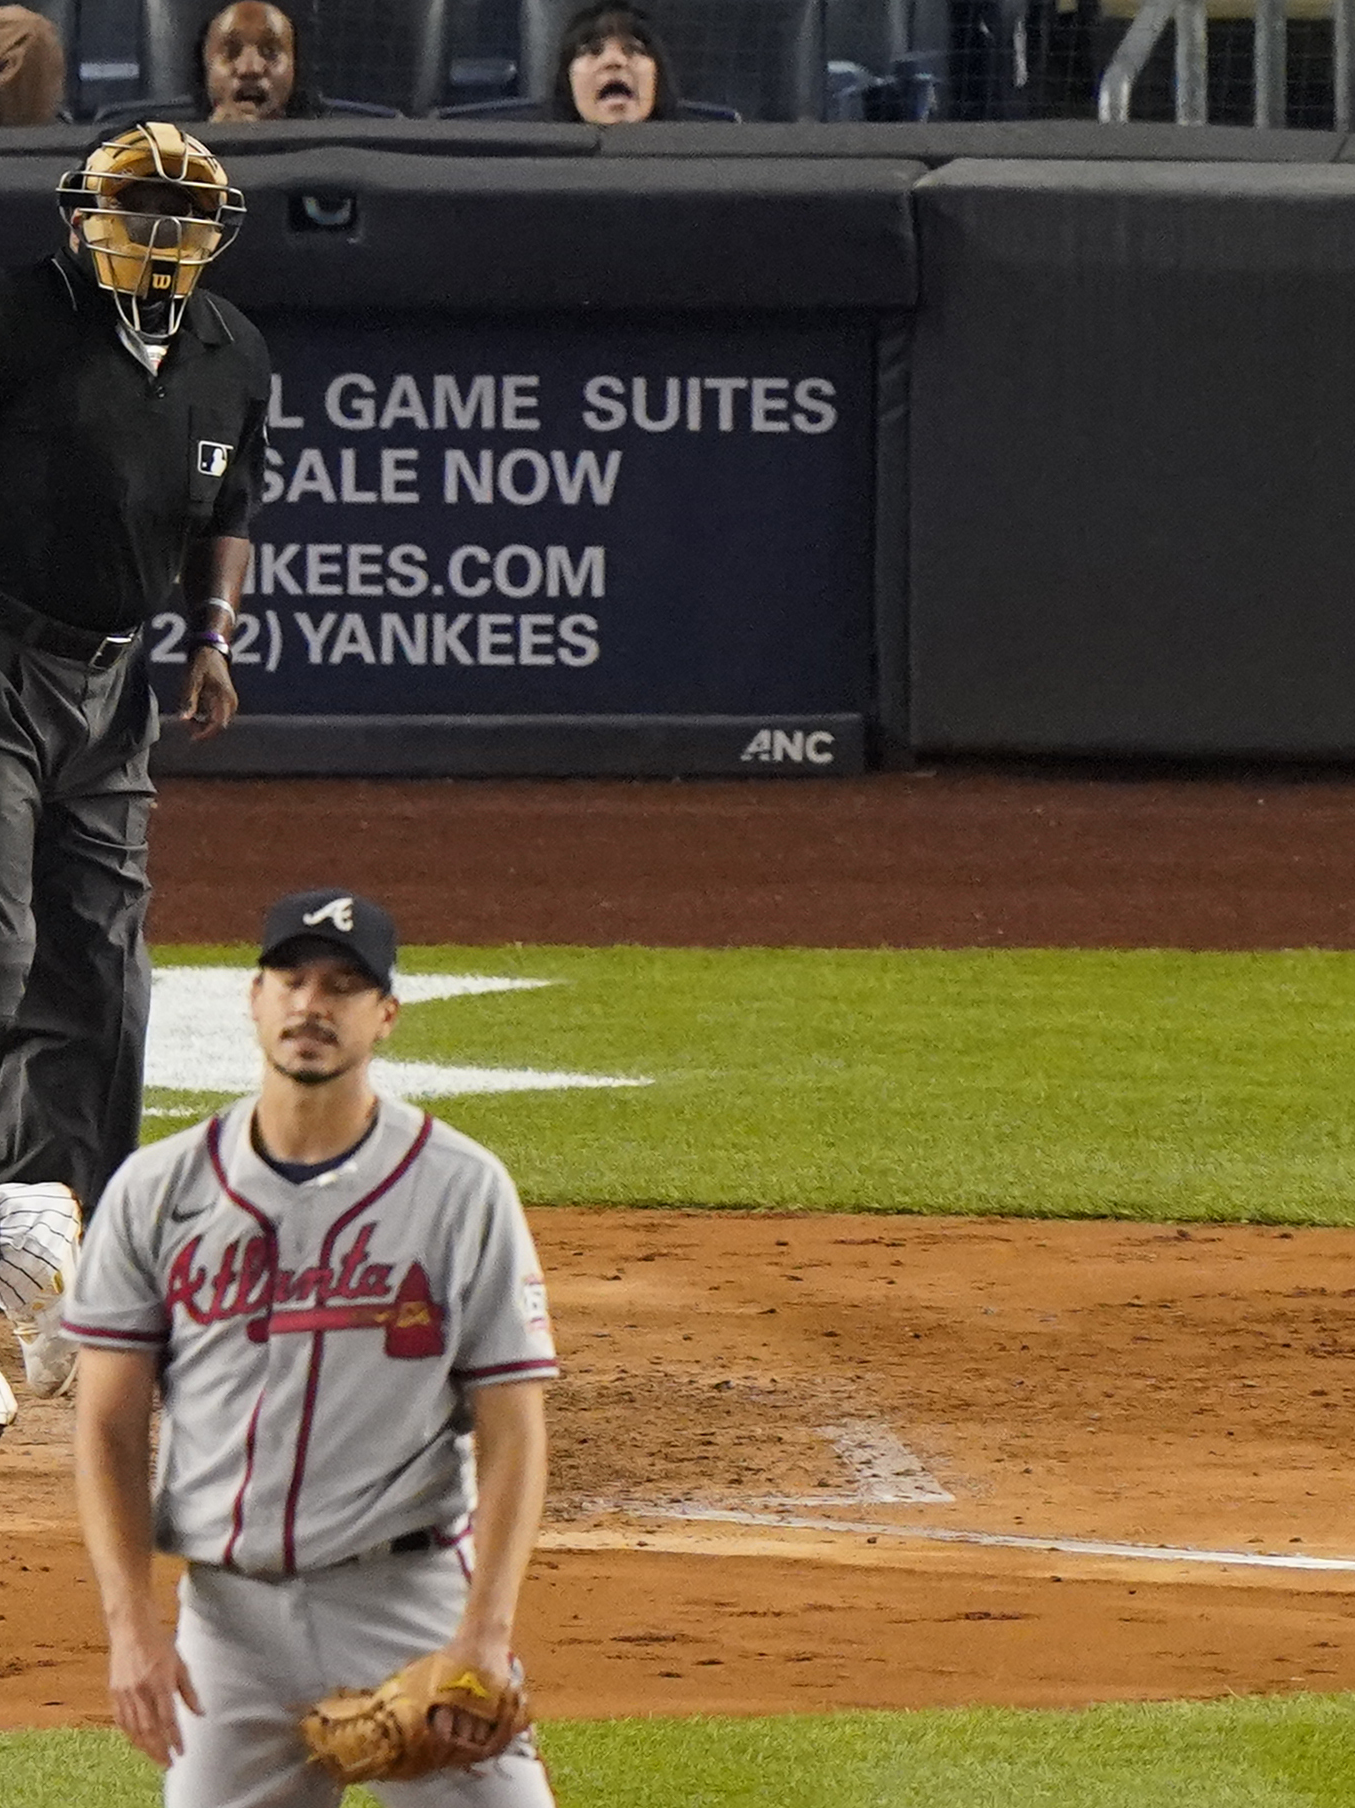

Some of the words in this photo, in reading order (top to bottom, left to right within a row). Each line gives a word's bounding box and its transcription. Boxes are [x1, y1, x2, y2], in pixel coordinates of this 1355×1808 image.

[324, 372, 541, 431] GAME
[582, 375, 838, 434] SUITES
[444, 449, 622, 506] NOW
[293, 612, 600, 667] YANKEES
[740, 729, 835, 764] ANC
